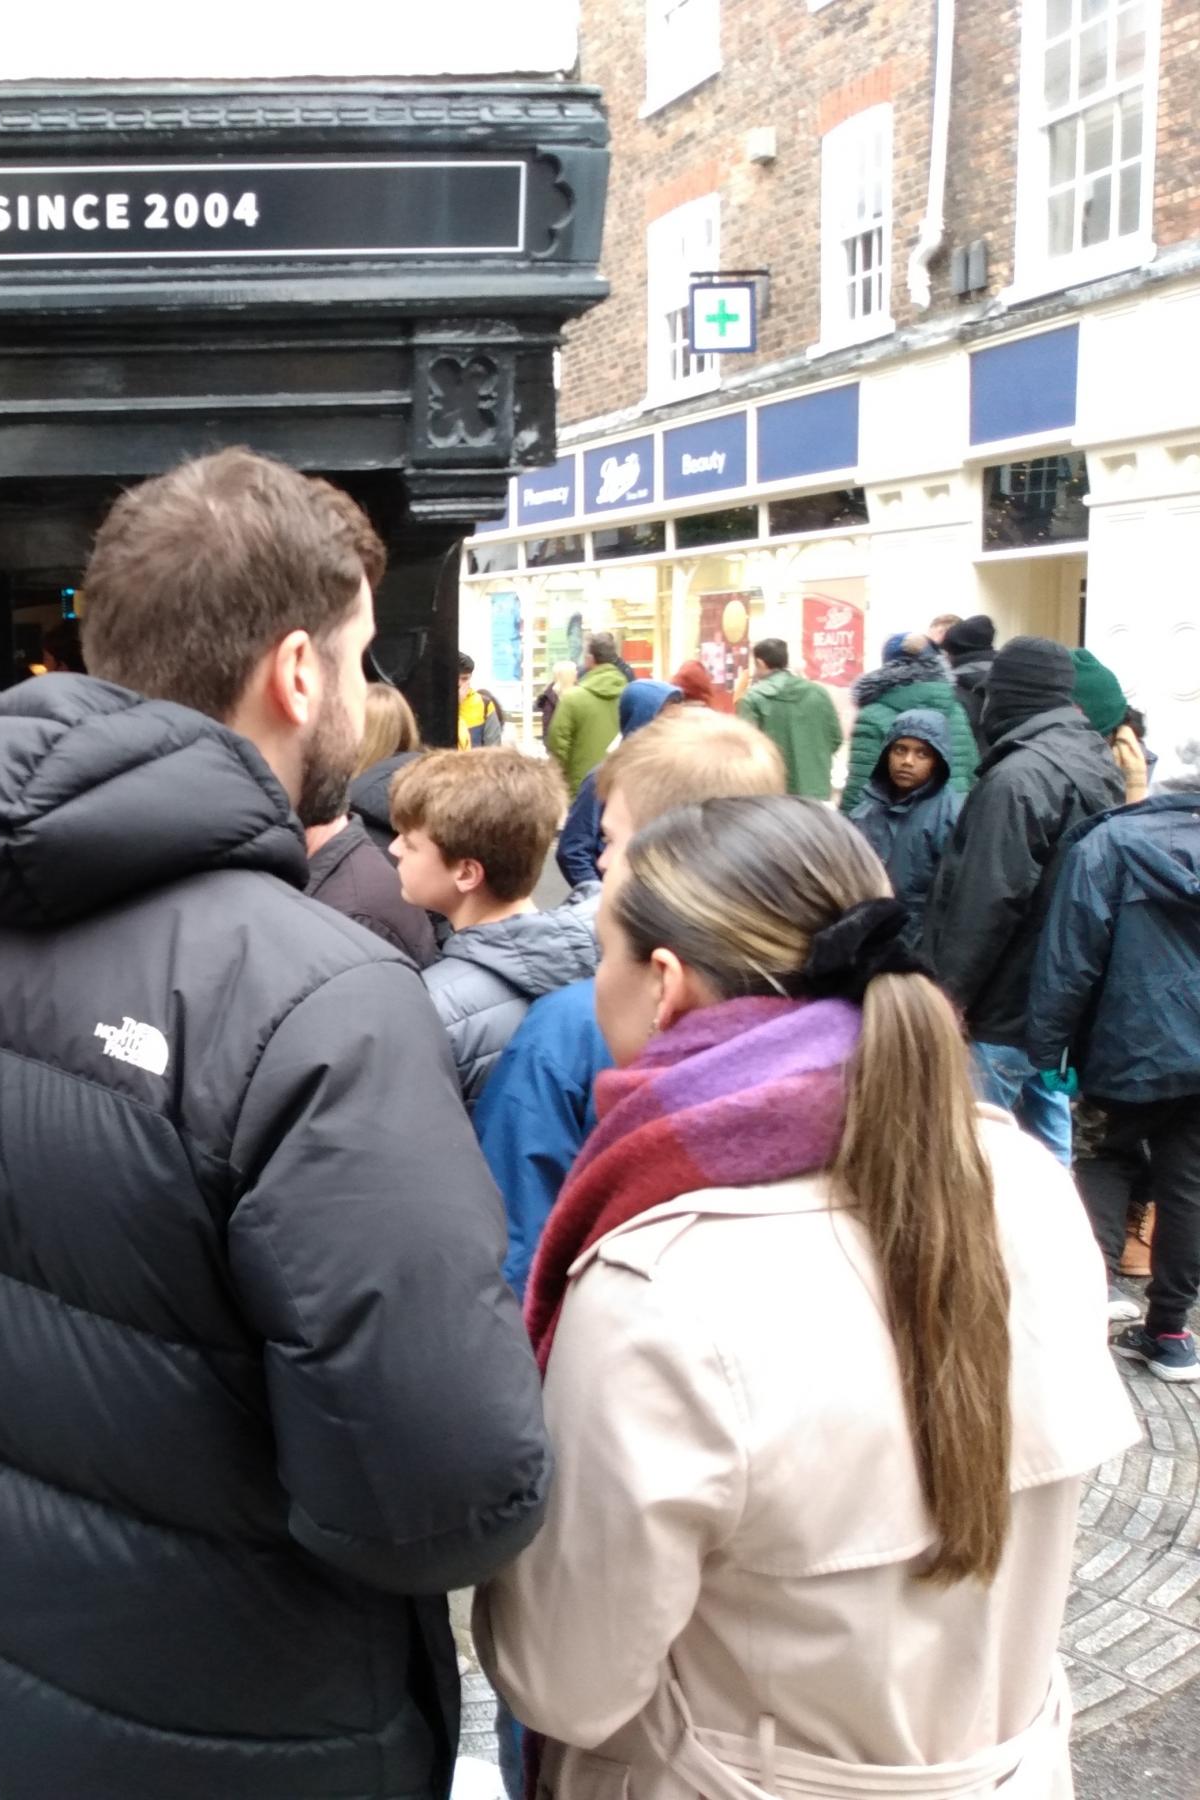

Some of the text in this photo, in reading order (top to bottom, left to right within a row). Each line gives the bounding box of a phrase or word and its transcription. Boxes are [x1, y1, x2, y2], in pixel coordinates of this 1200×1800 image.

[144, 192, 260, 230] 2004
[681, 450, 727, 476] Beauty
[813, 630, 855, 647] BEAUTY
